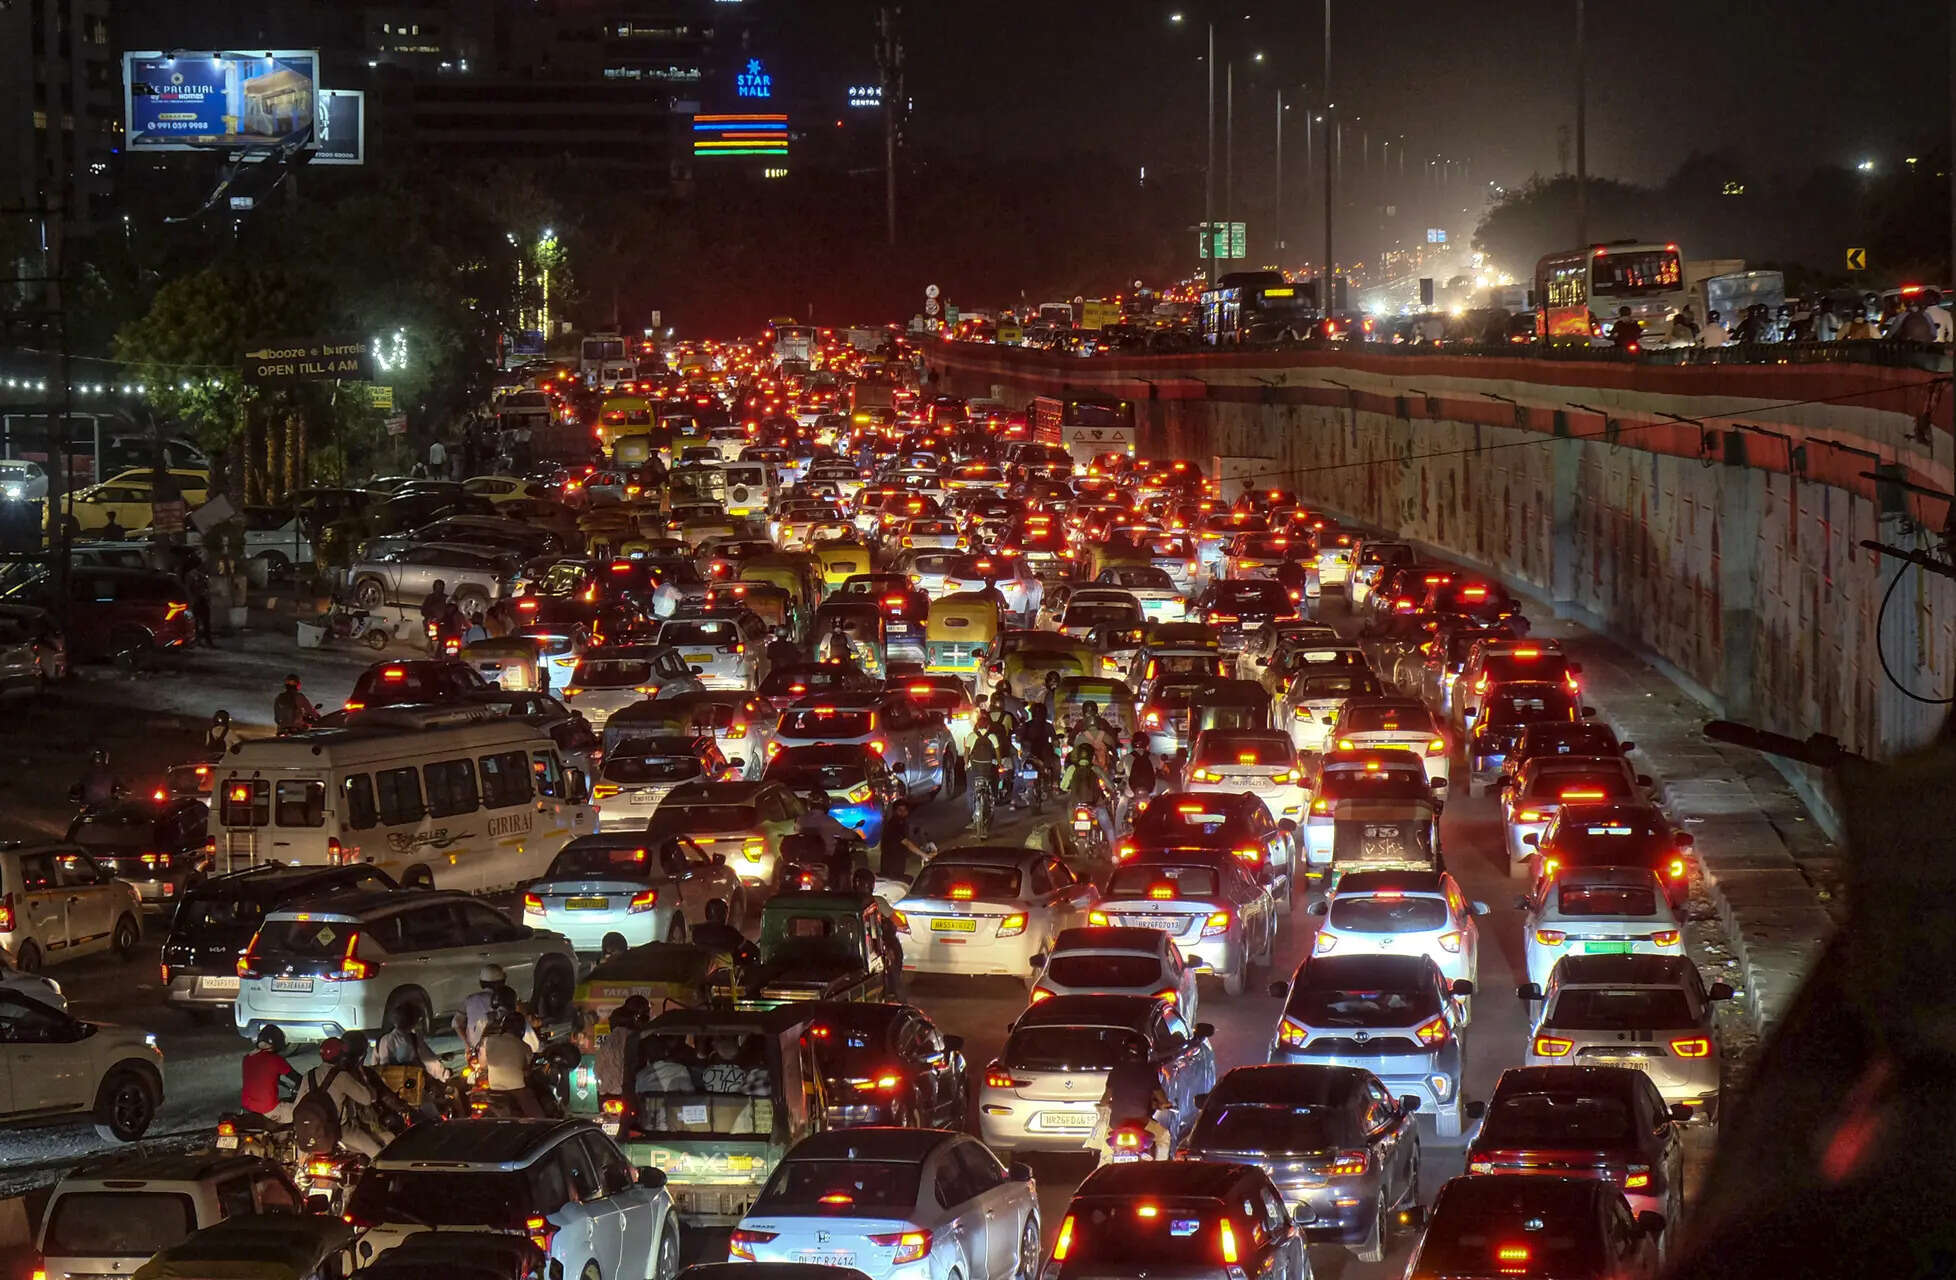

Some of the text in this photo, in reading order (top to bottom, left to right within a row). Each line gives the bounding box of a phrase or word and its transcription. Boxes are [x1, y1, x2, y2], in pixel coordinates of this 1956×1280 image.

[737, 75, 771, 86] STAR
[163, 85, 214, 94] PALATIAL
[739, 86, 771, 96] MALL
[268, 348, 305, 359] booze
[258, 360, 358, 376] OPEN TILL 4 AM
[487, 811, 533, 837] GIRIRAJ
